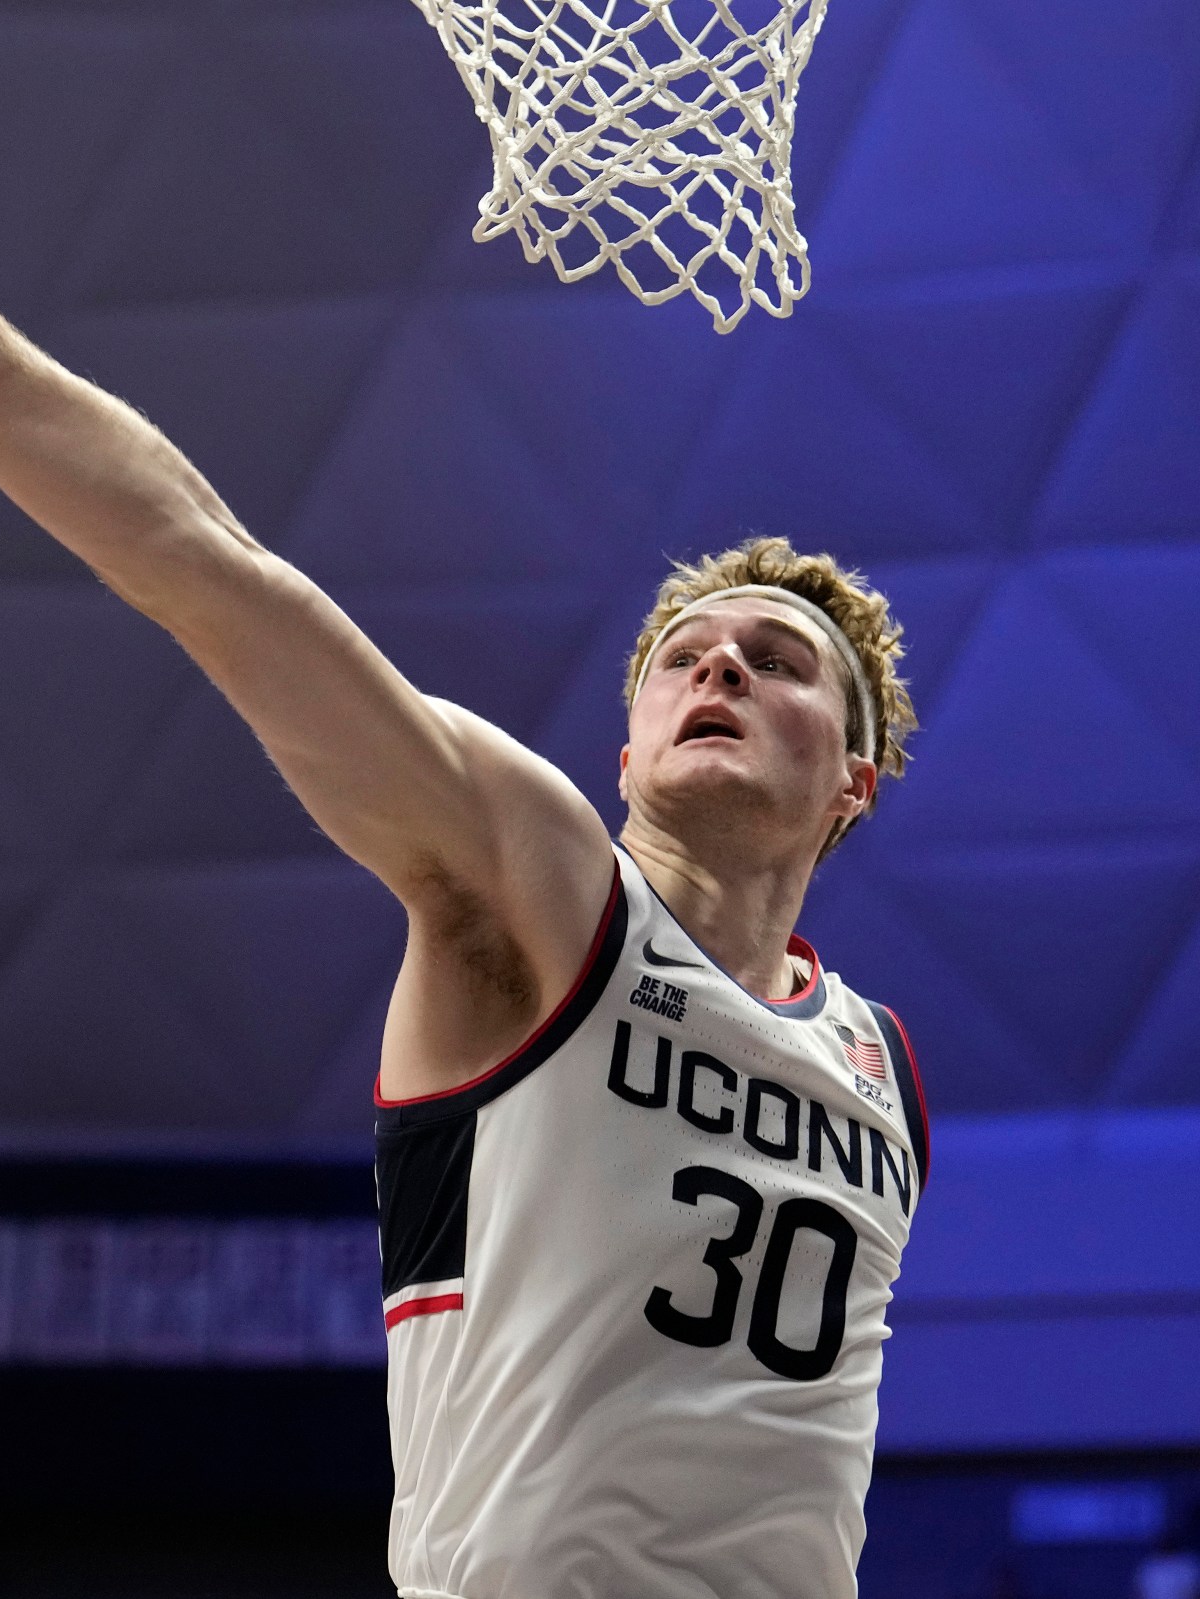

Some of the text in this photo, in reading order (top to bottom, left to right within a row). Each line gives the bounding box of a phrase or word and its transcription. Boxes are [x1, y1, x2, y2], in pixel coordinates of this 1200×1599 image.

[629, 989, 687, 1023] CHANGE
[639, 974, 689, 1006] BE THE
[608, 1019, 911, 1219] UCONN
[643, 1165, 858, 1381] 30
